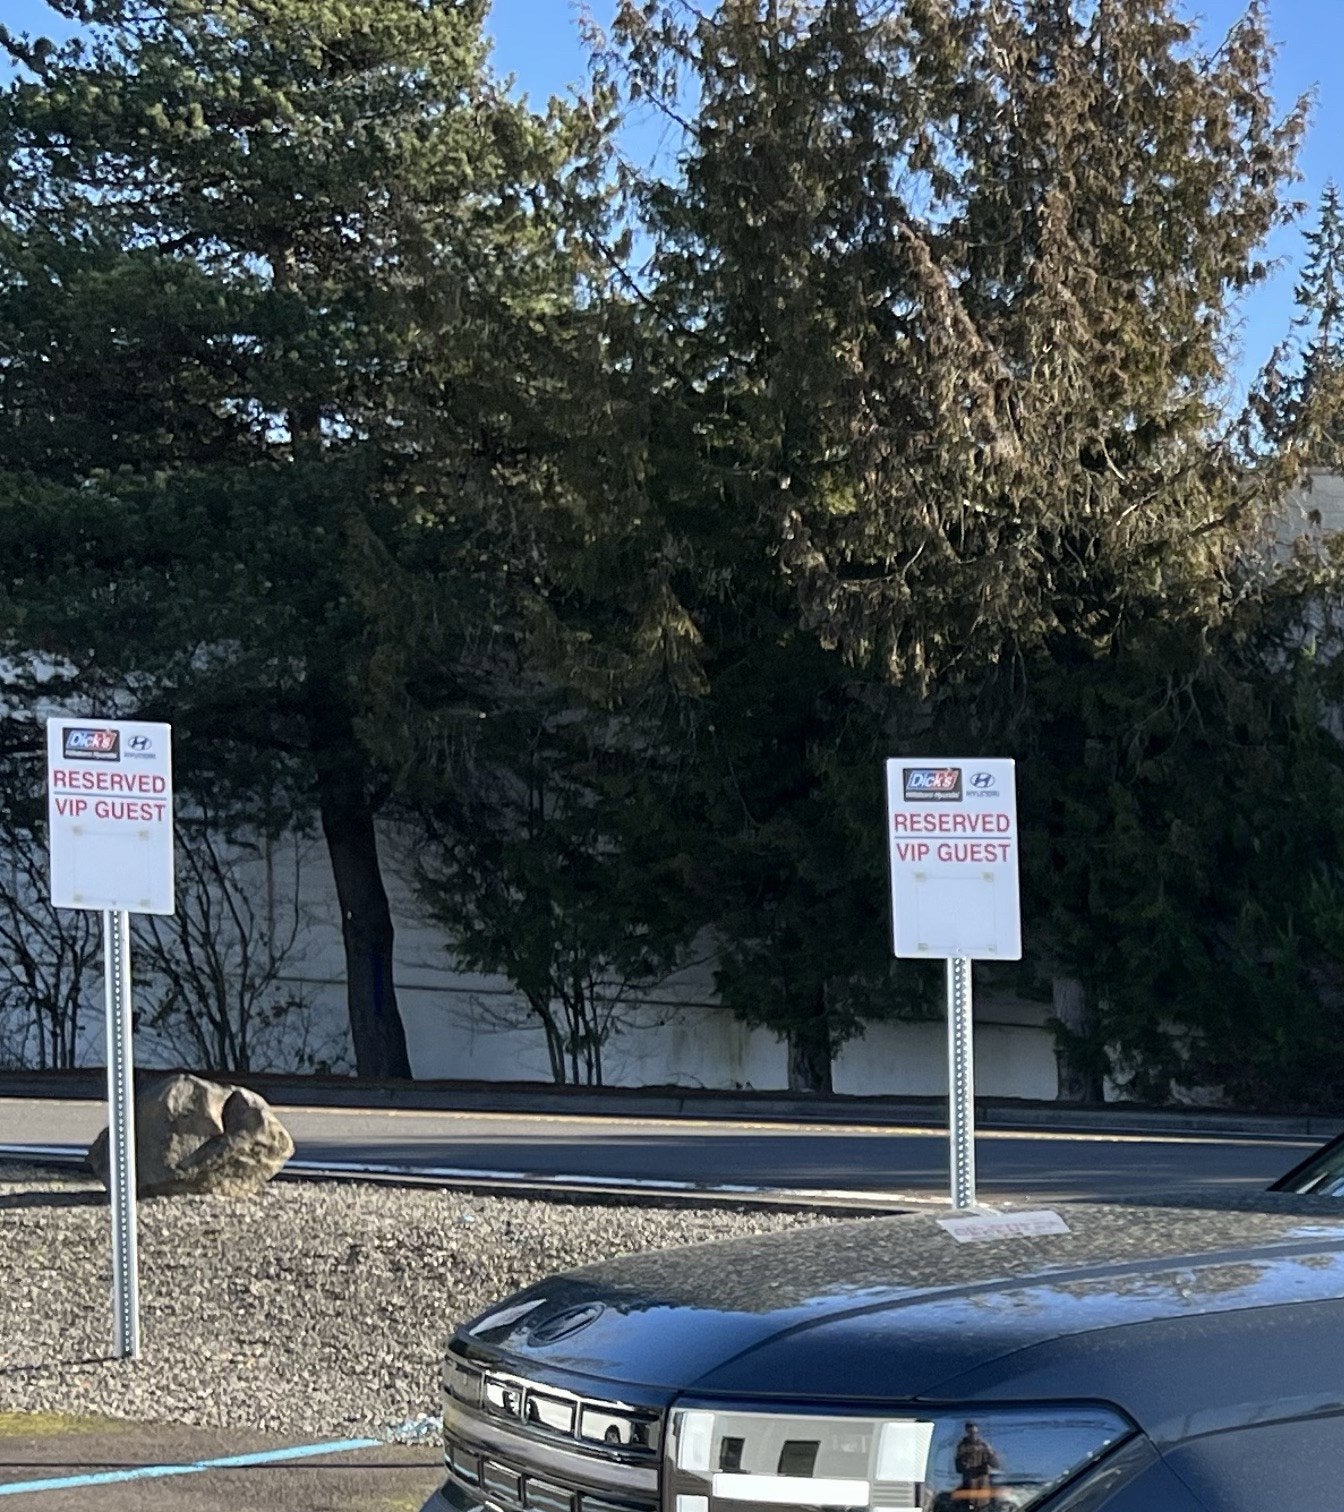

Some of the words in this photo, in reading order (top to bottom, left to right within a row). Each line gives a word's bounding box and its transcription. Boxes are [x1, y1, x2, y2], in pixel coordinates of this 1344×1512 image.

[53, 769, 166, 793] RESERVED
[55, 798, 88, 816] VIP
[94, 801, 166, 821] GUEST
[894, 813, 1010, 833] RESERVED
[896, 843, 929, 861] VIP
[938, 843, 1011, 862] GUEST
